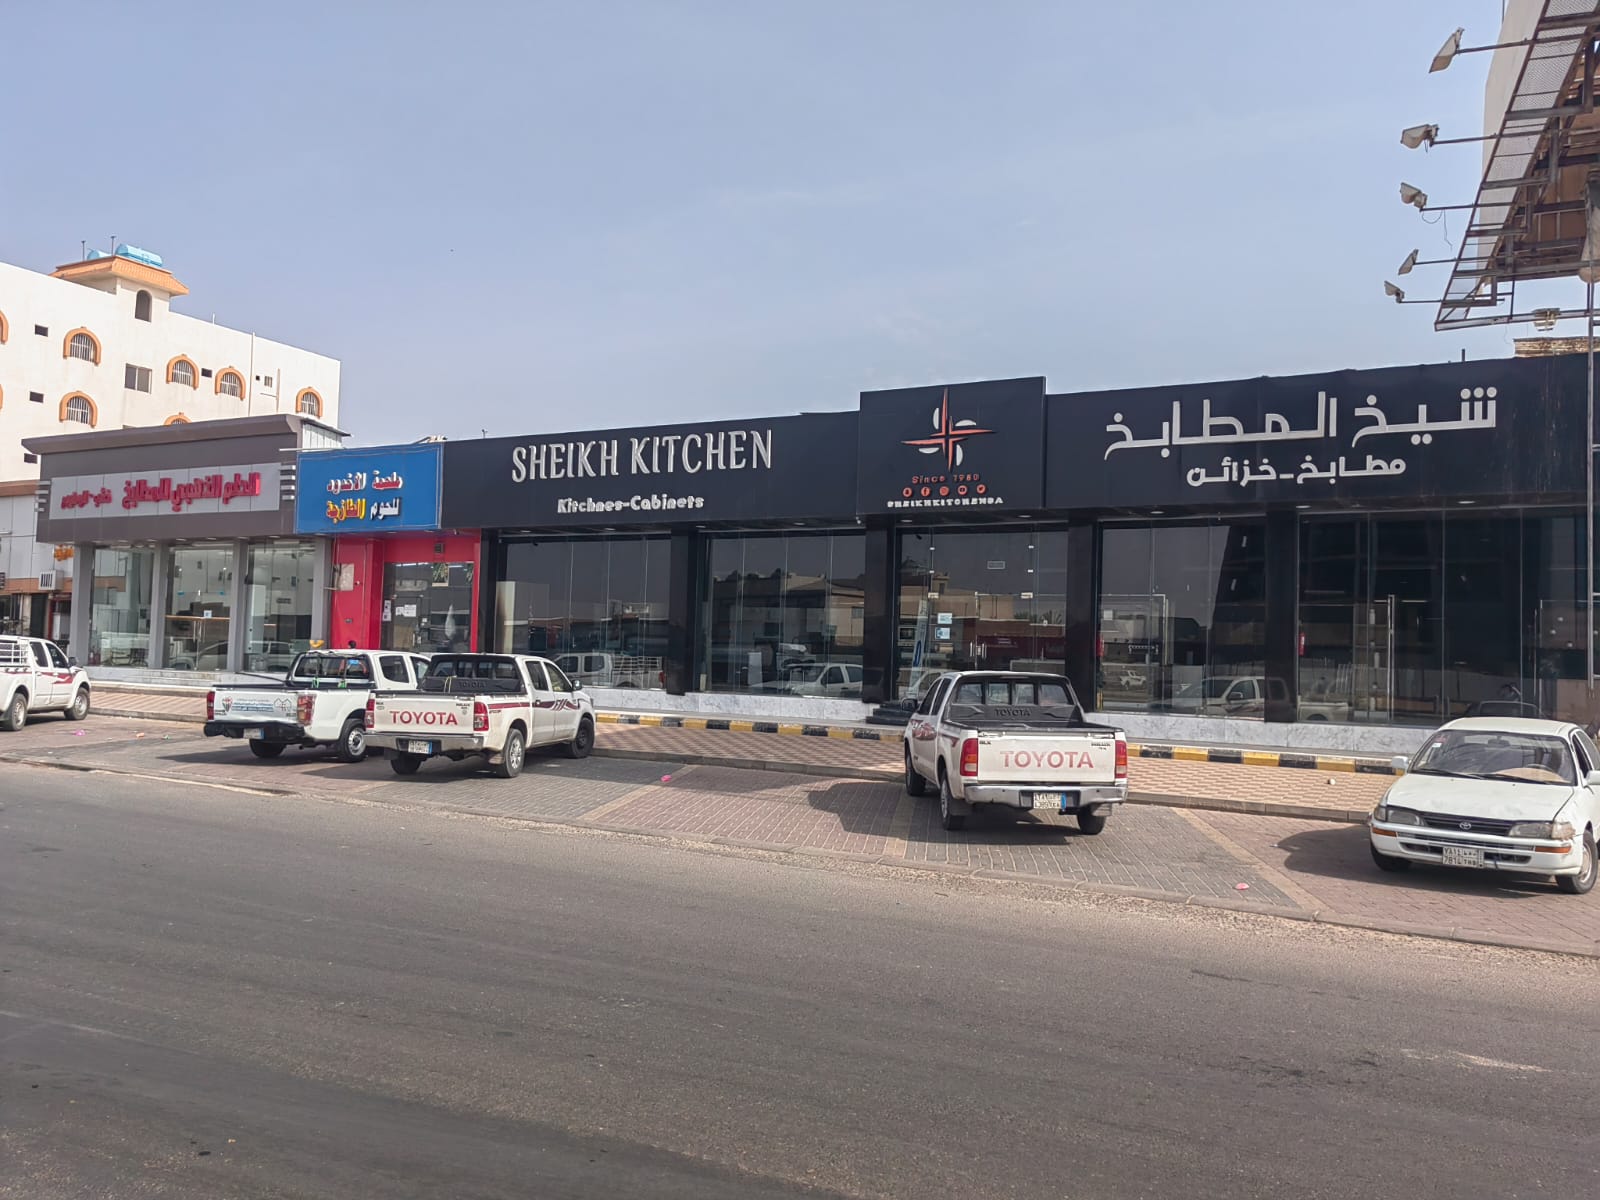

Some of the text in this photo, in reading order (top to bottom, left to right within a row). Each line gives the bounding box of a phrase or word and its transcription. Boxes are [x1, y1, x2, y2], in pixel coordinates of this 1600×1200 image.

[1103, 386, 1498, 461] شيخ المطابخ
[511, 429, 773, 483] SHEIKH KITCHEN
[911, 474, 946, 485] Since
[389, 710, 459, 726] TOYOTA
[994, 708, 1033, 717] TOYOTA
[999, 750, 1095, 769] TOYOTA
